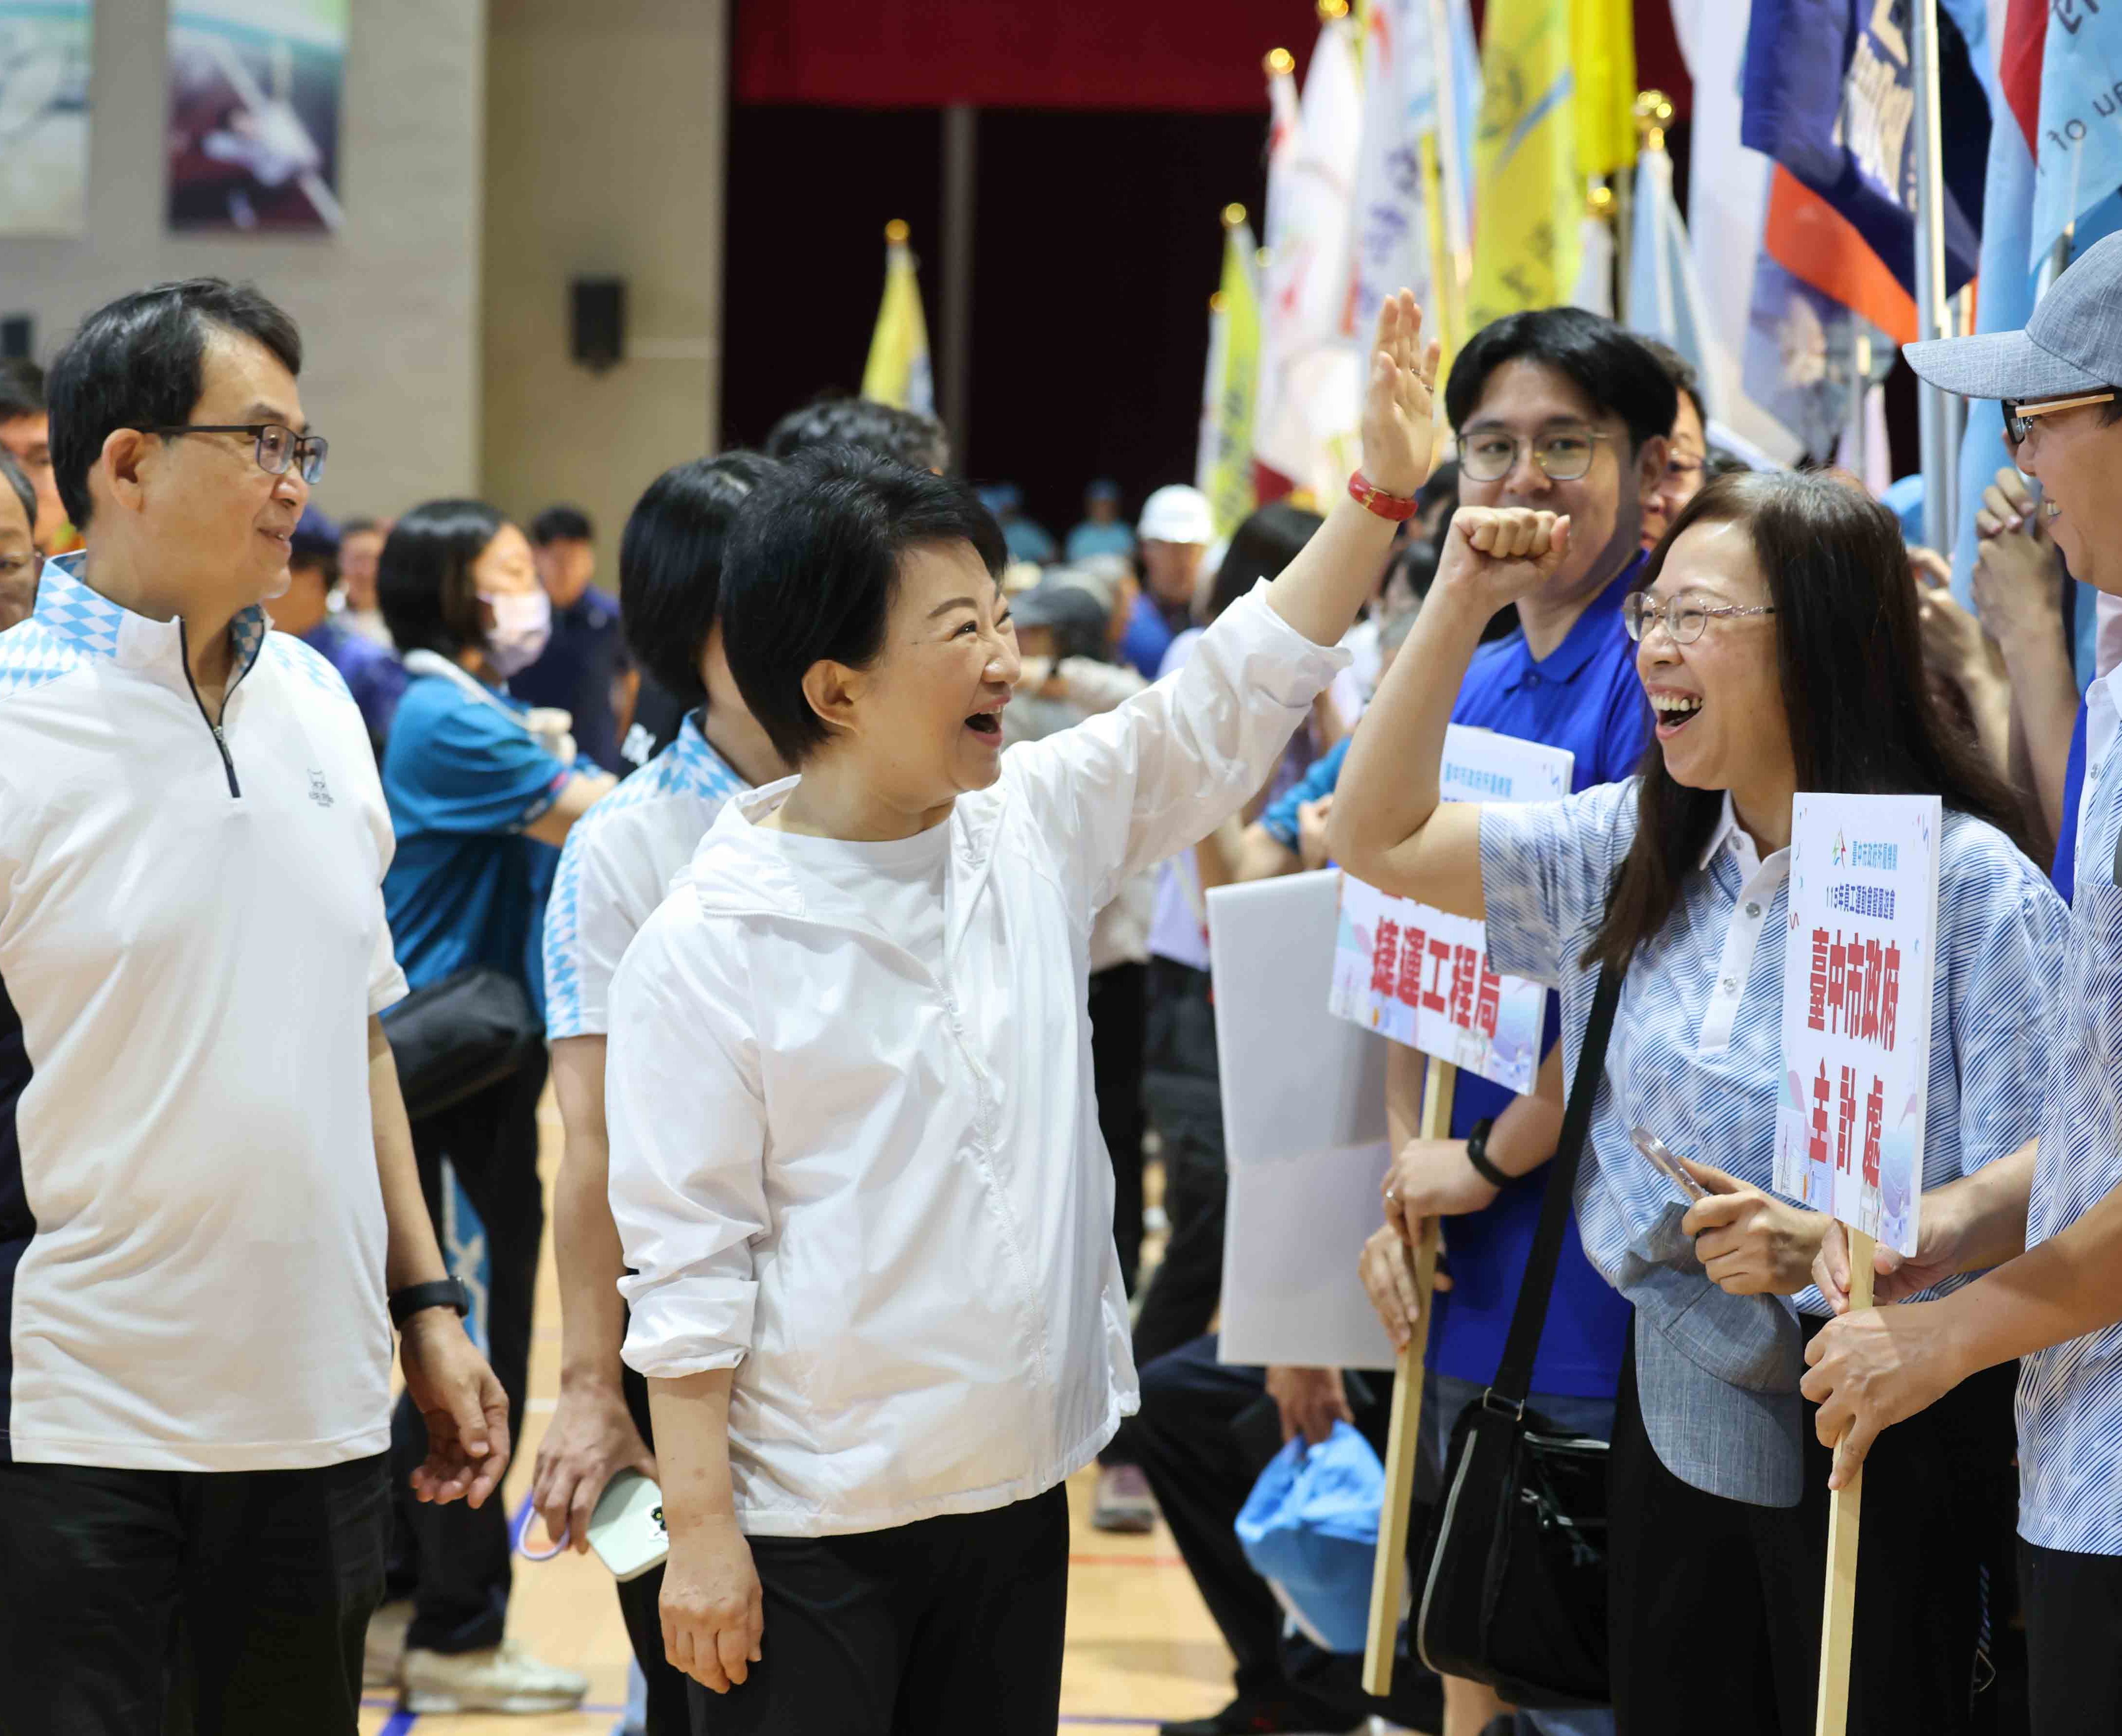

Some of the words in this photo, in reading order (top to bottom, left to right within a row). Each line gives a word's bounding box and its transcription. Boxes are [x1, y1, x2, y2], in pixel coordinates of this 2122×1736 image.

[1371, 916, 1501, 1039] 捷運工程局
[1808, 927, 1901, 1052] 臺中市政府
[1810, 1057, 1884, 1188] 主計處
